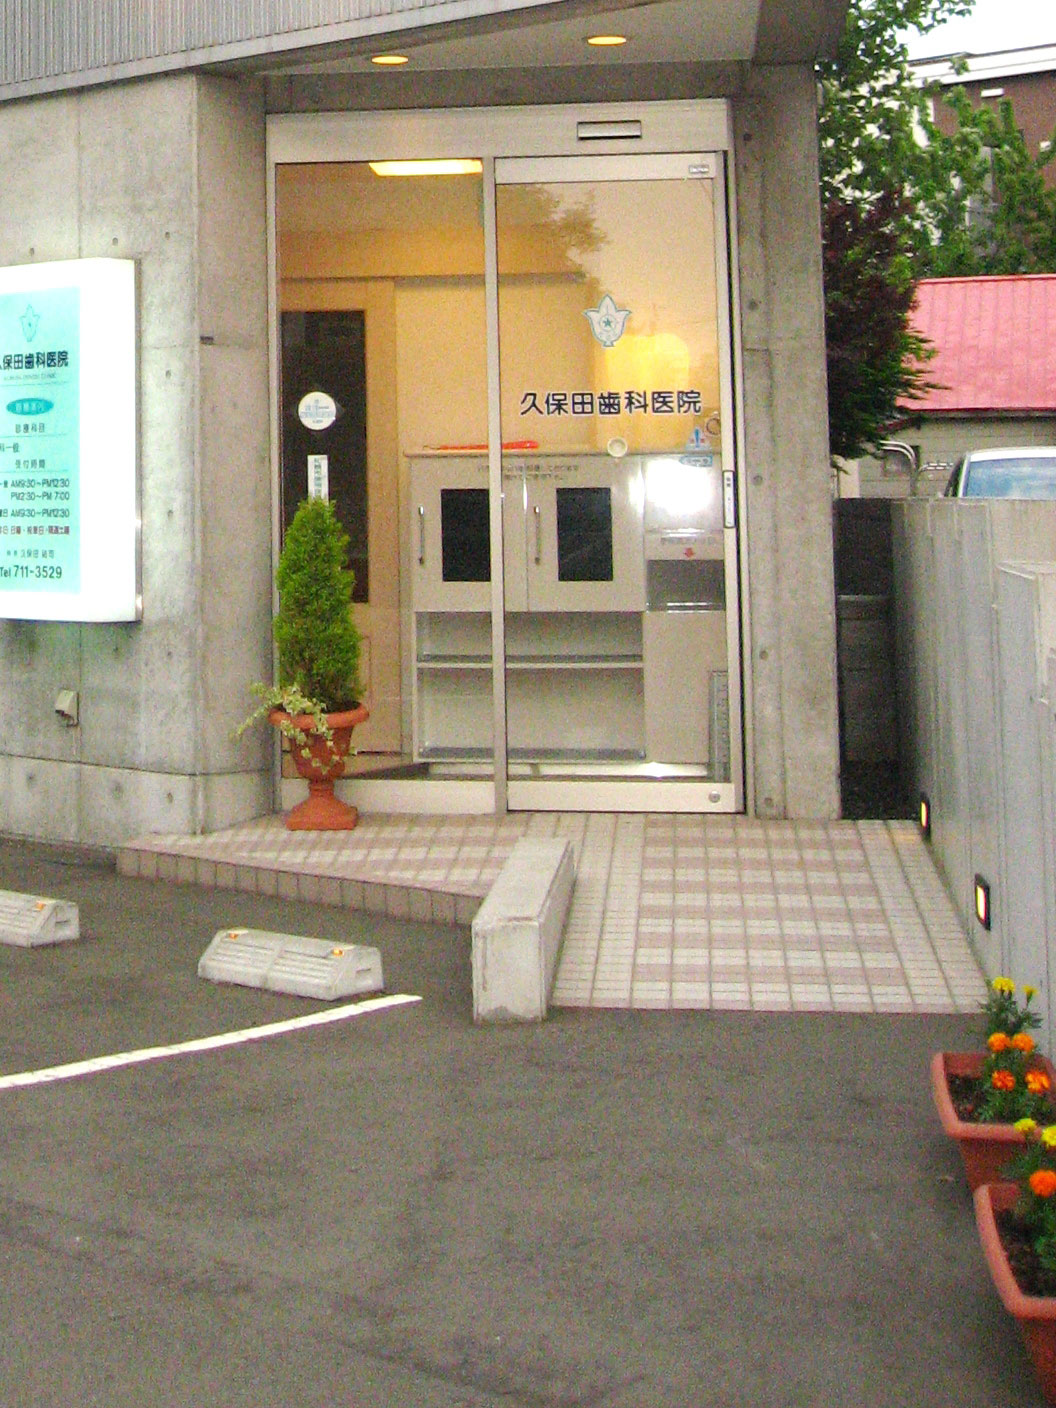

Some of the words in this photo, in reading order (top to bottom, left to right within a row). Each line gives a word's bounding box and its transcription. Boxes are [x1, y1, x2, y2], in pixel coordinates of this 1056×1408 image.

[520, 389, 702, 416] 久保田歯科医院
[0, 566, 11, 579] Tel
[13, 565, 63, 579] 711-3529
